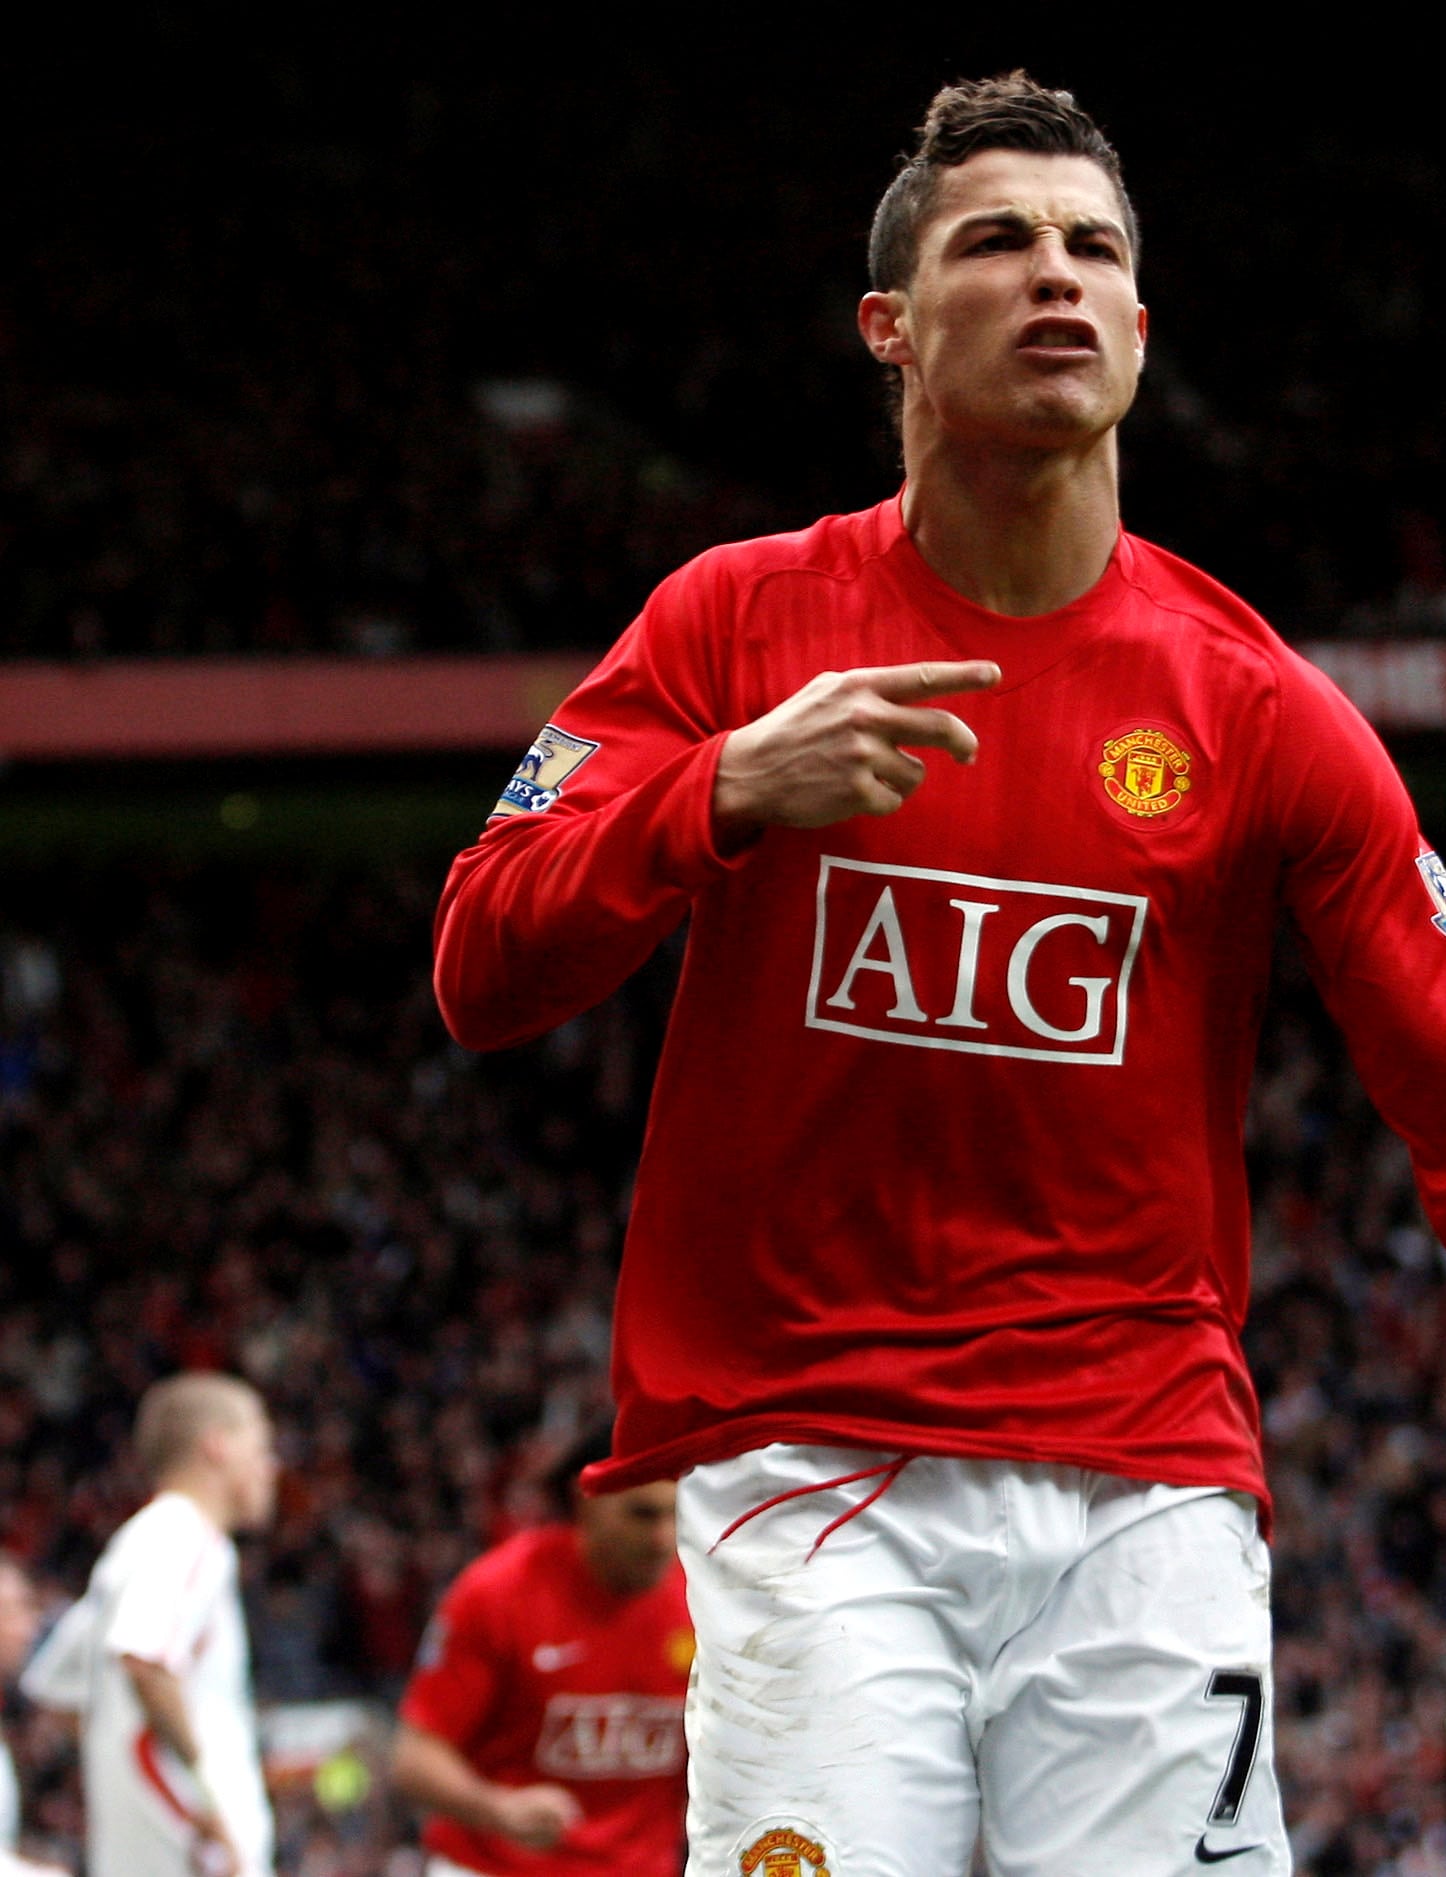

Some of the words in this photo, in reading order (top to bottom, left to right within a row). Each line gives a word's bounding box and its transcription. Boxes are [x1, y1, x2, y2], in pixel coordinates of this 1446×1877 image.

[1109, 735, 1183, 770] MANCHESTER
[1116, 791, 1168, 811] UNITED
[826, 885, 1111, 1042] AIG
[1205, 1669, 1265, 1826] 7
